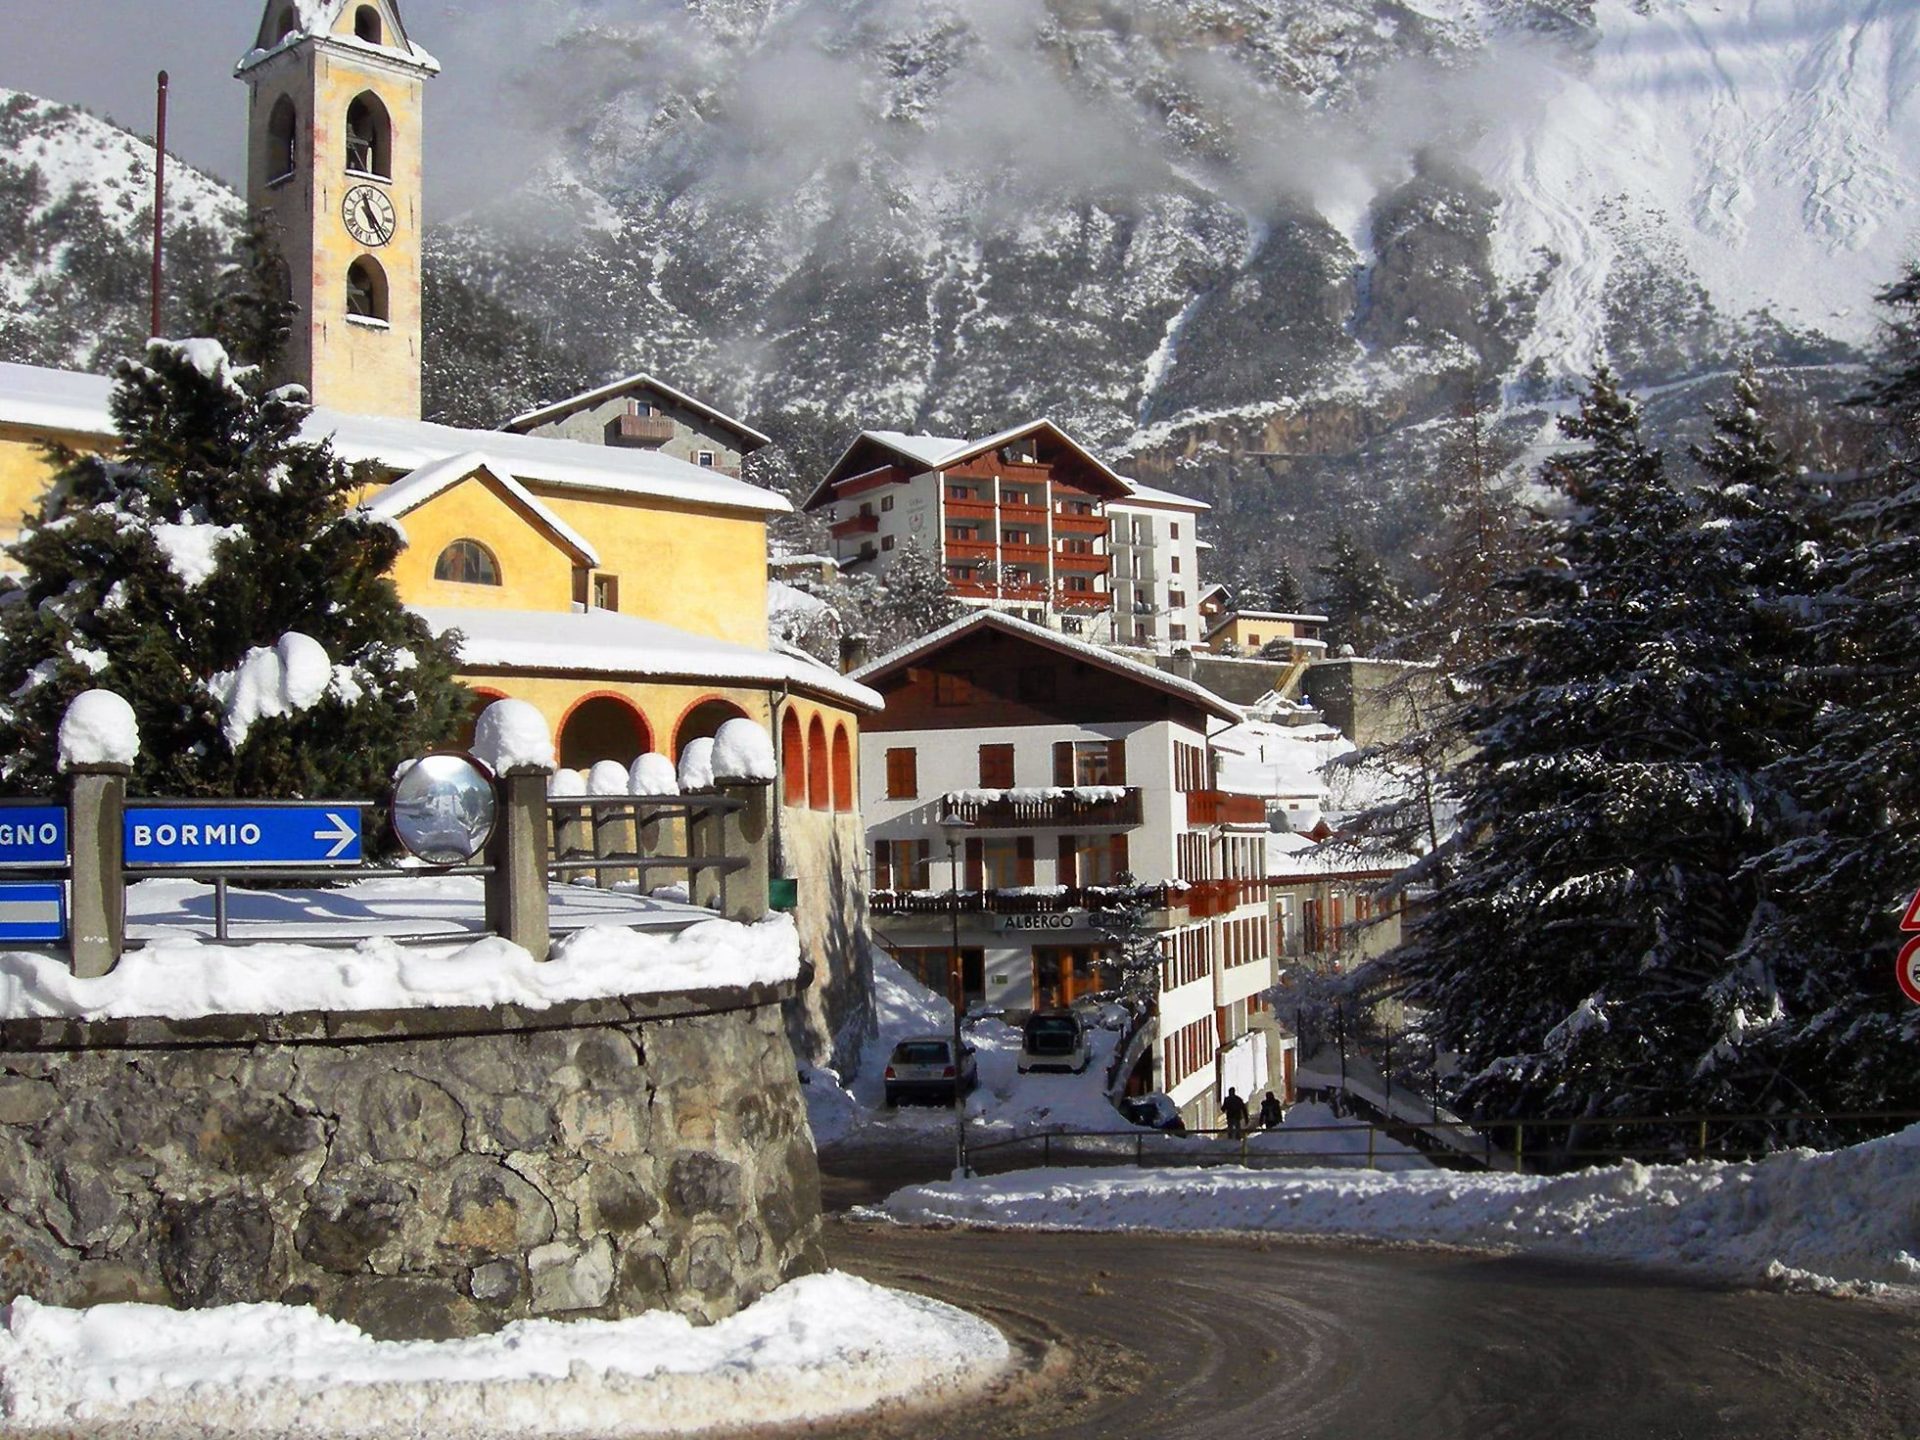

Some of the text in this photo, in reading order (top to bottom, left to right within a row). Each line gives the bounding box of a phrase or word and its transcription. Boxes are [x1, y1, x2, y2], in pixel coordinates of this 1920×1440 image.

[0, 823, 57, 845] GNO
[134, 823, 261, 846] BORMIO
[1004, 914, 1074, 929] ALBERGO
